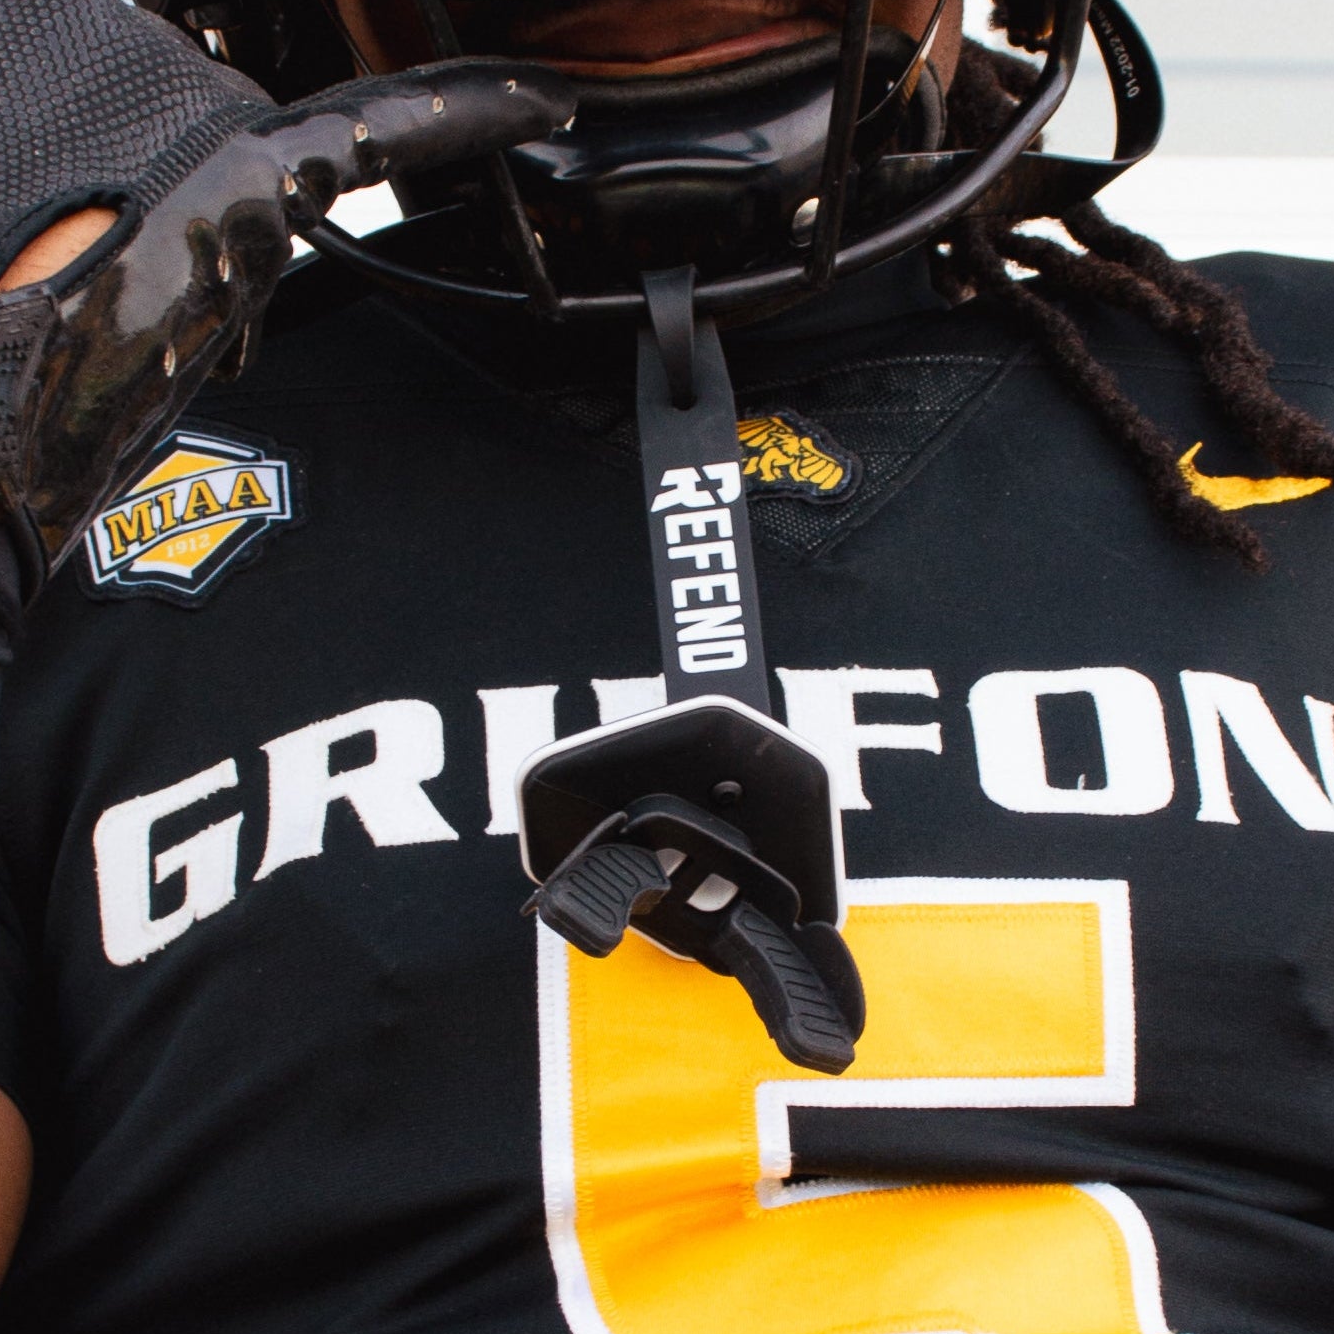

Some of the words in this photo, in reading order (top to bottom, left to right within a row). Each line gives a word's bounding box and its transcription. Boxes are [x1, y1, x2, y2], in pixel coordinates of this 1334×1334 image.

[105, 470, 271, 558] MIAA
[167, 534, 211, 559] 1912
[650, 462, 747, 673] REFEND
